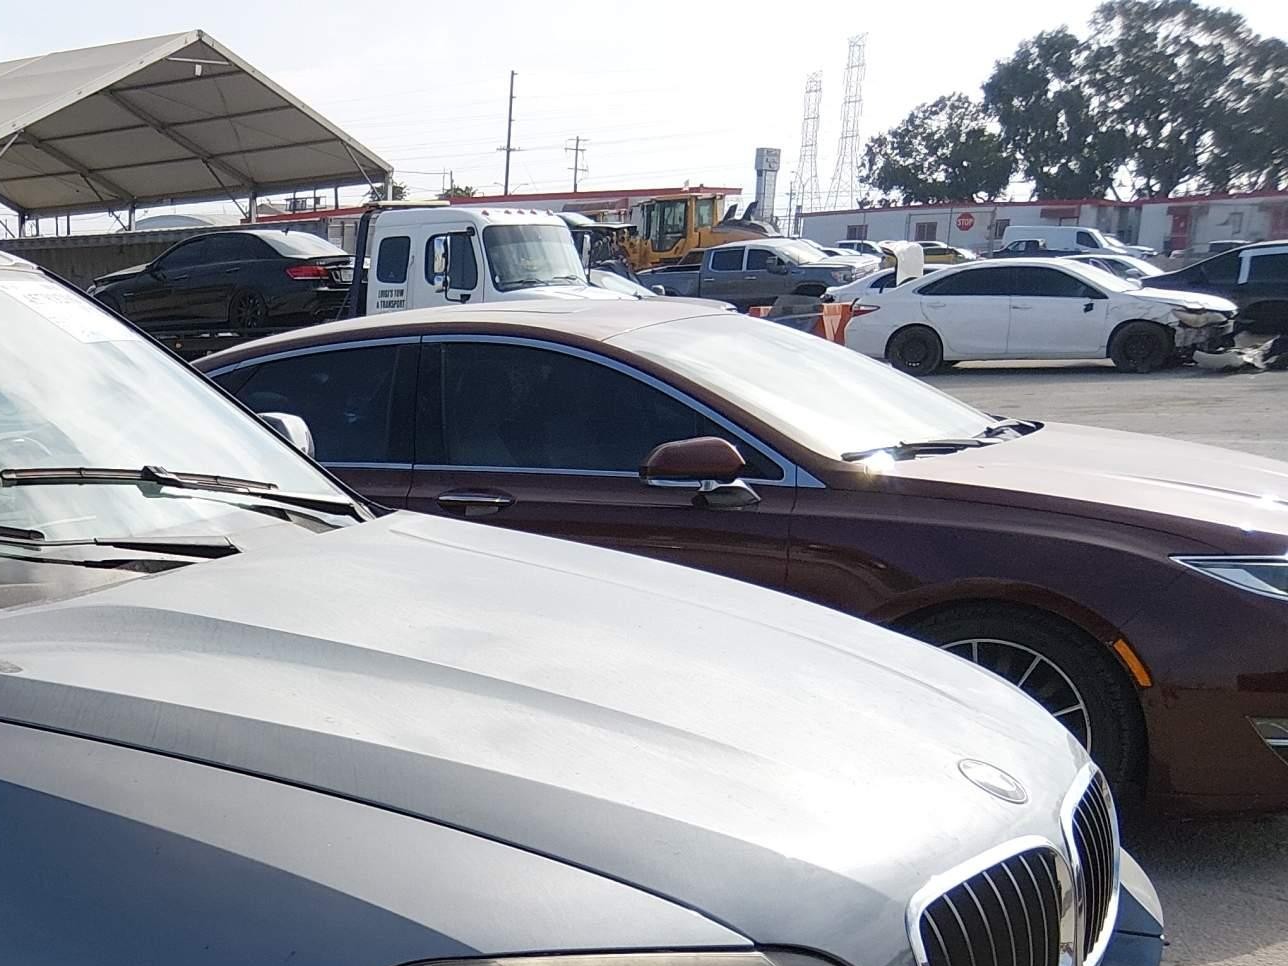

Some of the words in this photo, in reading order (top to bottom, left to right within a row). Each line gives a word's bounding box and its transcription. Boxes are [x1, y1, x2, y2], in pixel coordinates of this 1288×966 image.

[957, 218, 973, 226] STOP
[378, 289, 393, 298] LUIGI'S
[394, 289, 405, 298] TOW
[381, 299, 406, 309] TRANSPORT
